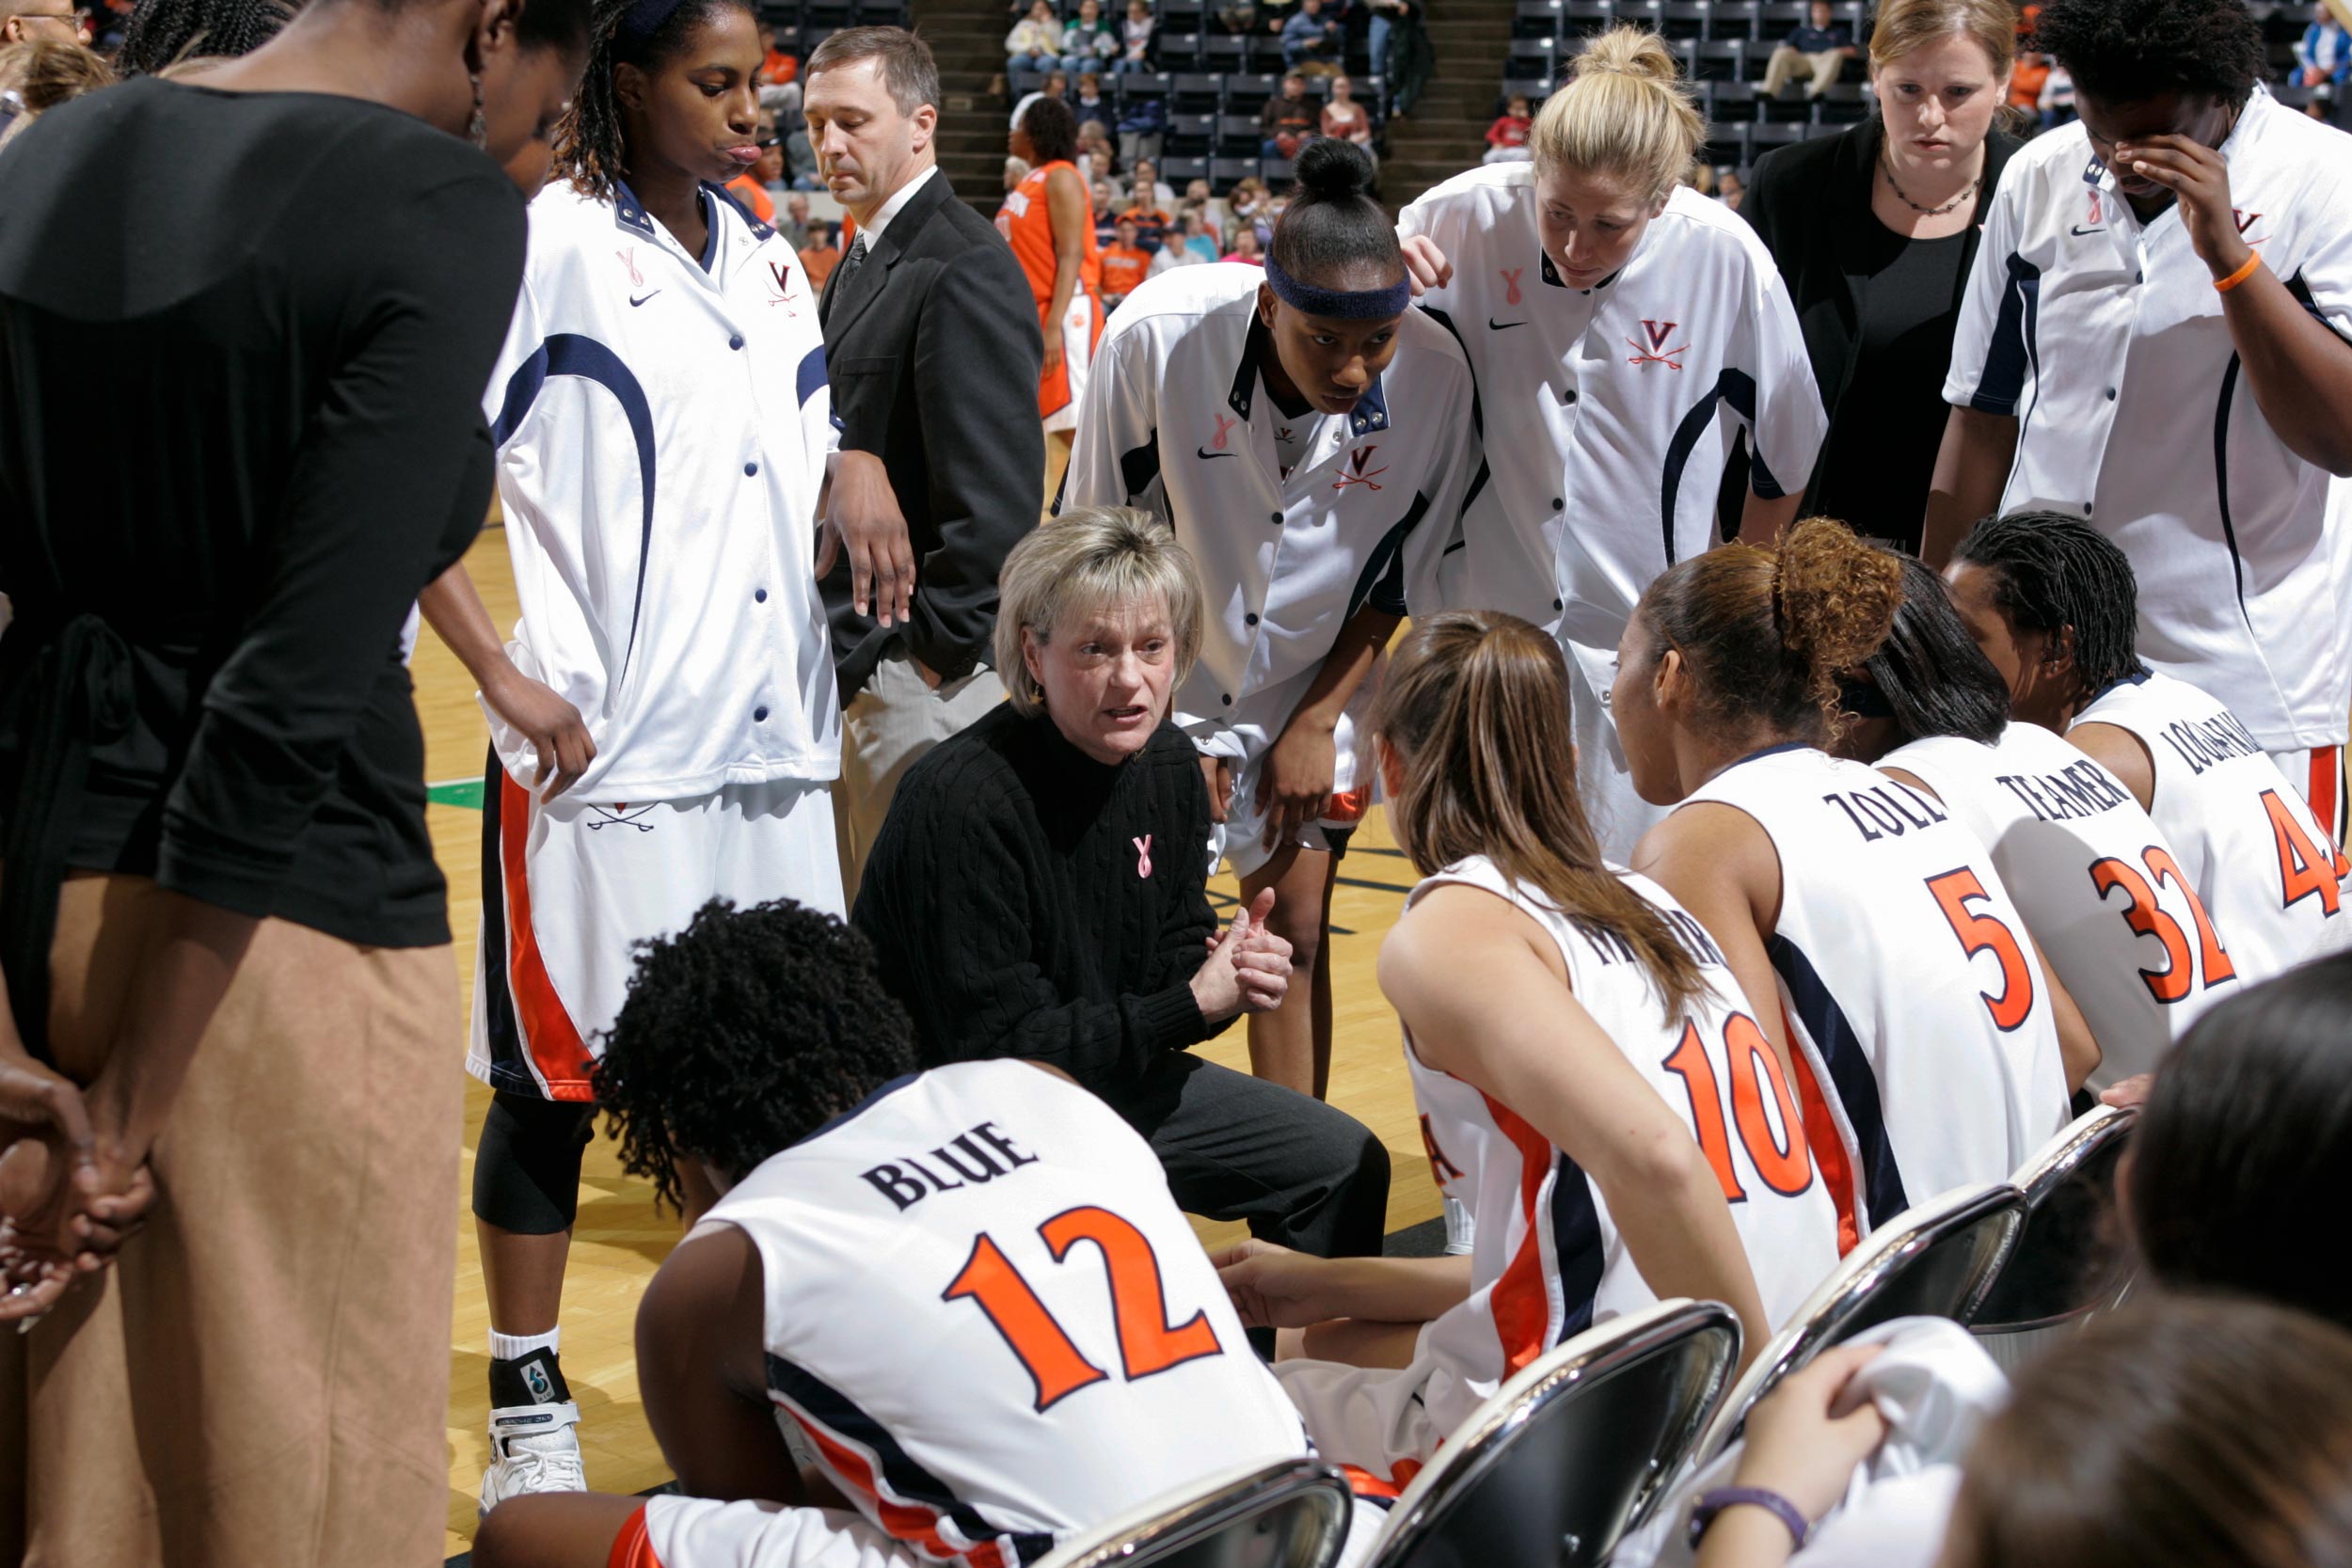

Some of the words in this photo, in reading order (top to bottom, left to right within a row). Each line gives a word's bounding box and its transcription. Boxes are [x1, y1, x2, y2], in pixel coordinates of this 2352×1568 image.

[2233, 209, 2263, 235] V
[768, 261, 790, 293] V
[1640, 320, 1677, 353] V
[1352, 445, 1378, 476] V
[1821, 781, 1948, 843] ZOLL
[1994, 759, 2131, 821] TEAMER
[1923, 864, 2033, 1033] 5
[2088, 845, 2237, 1005] 32
[1661, 1010, 1814, 1204] 10
[858, 1121, 1041, 1213] BLUE
[941, 1205, 1225, 1415] 12
